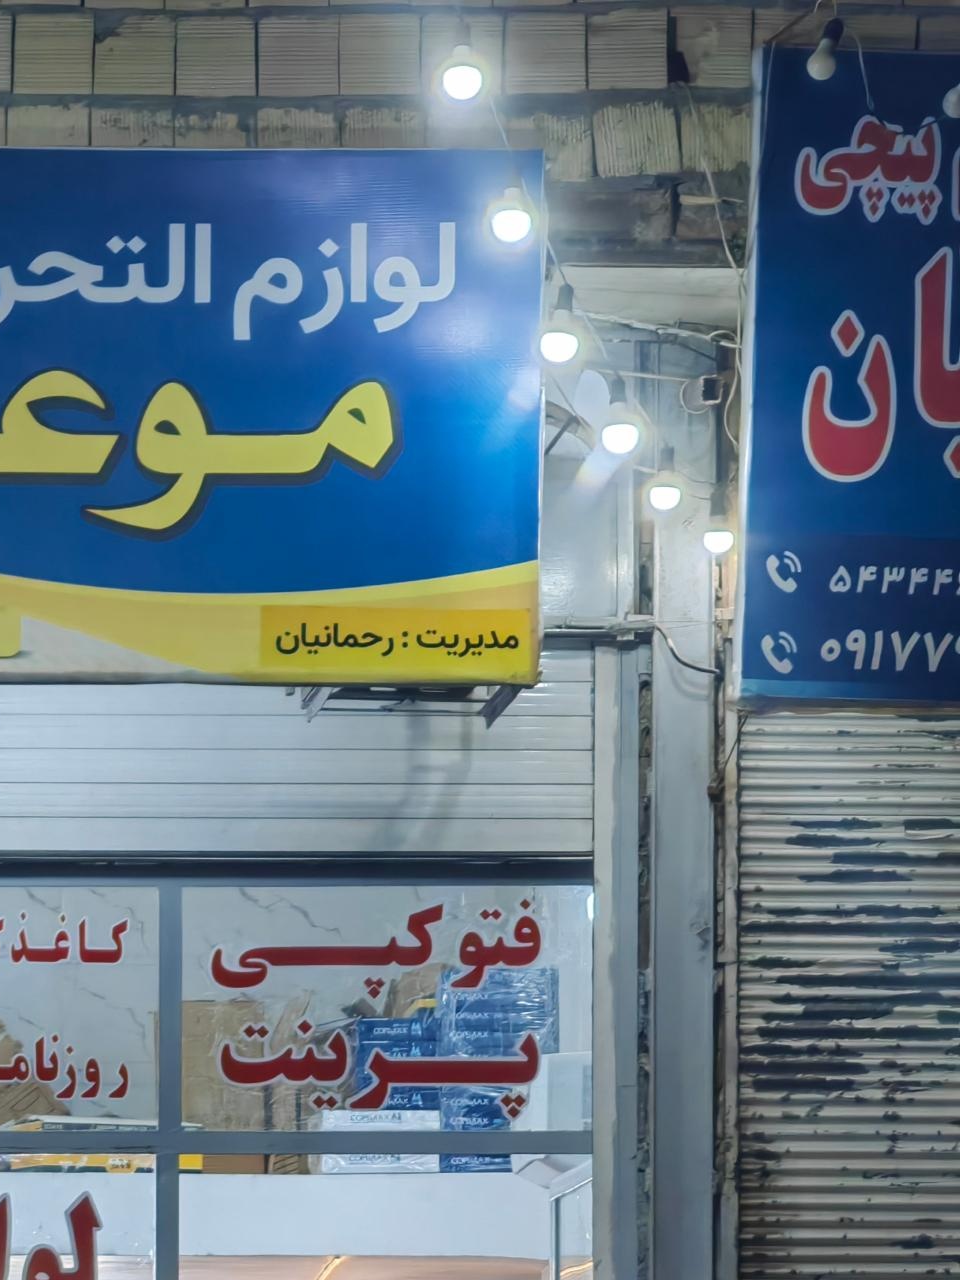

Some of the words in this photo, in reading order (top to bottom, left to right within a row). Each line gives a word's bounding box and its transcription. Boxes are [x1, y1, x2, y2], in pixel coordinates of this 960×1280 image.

[232, 221, 457, 341] لوازم
[802, 246, 960, 483] ان
[275, 621, 395, 656] رحمانیان
[416, 628, 519, 656] مدیریت
[218, 1020, 541, 1119] پرینت
